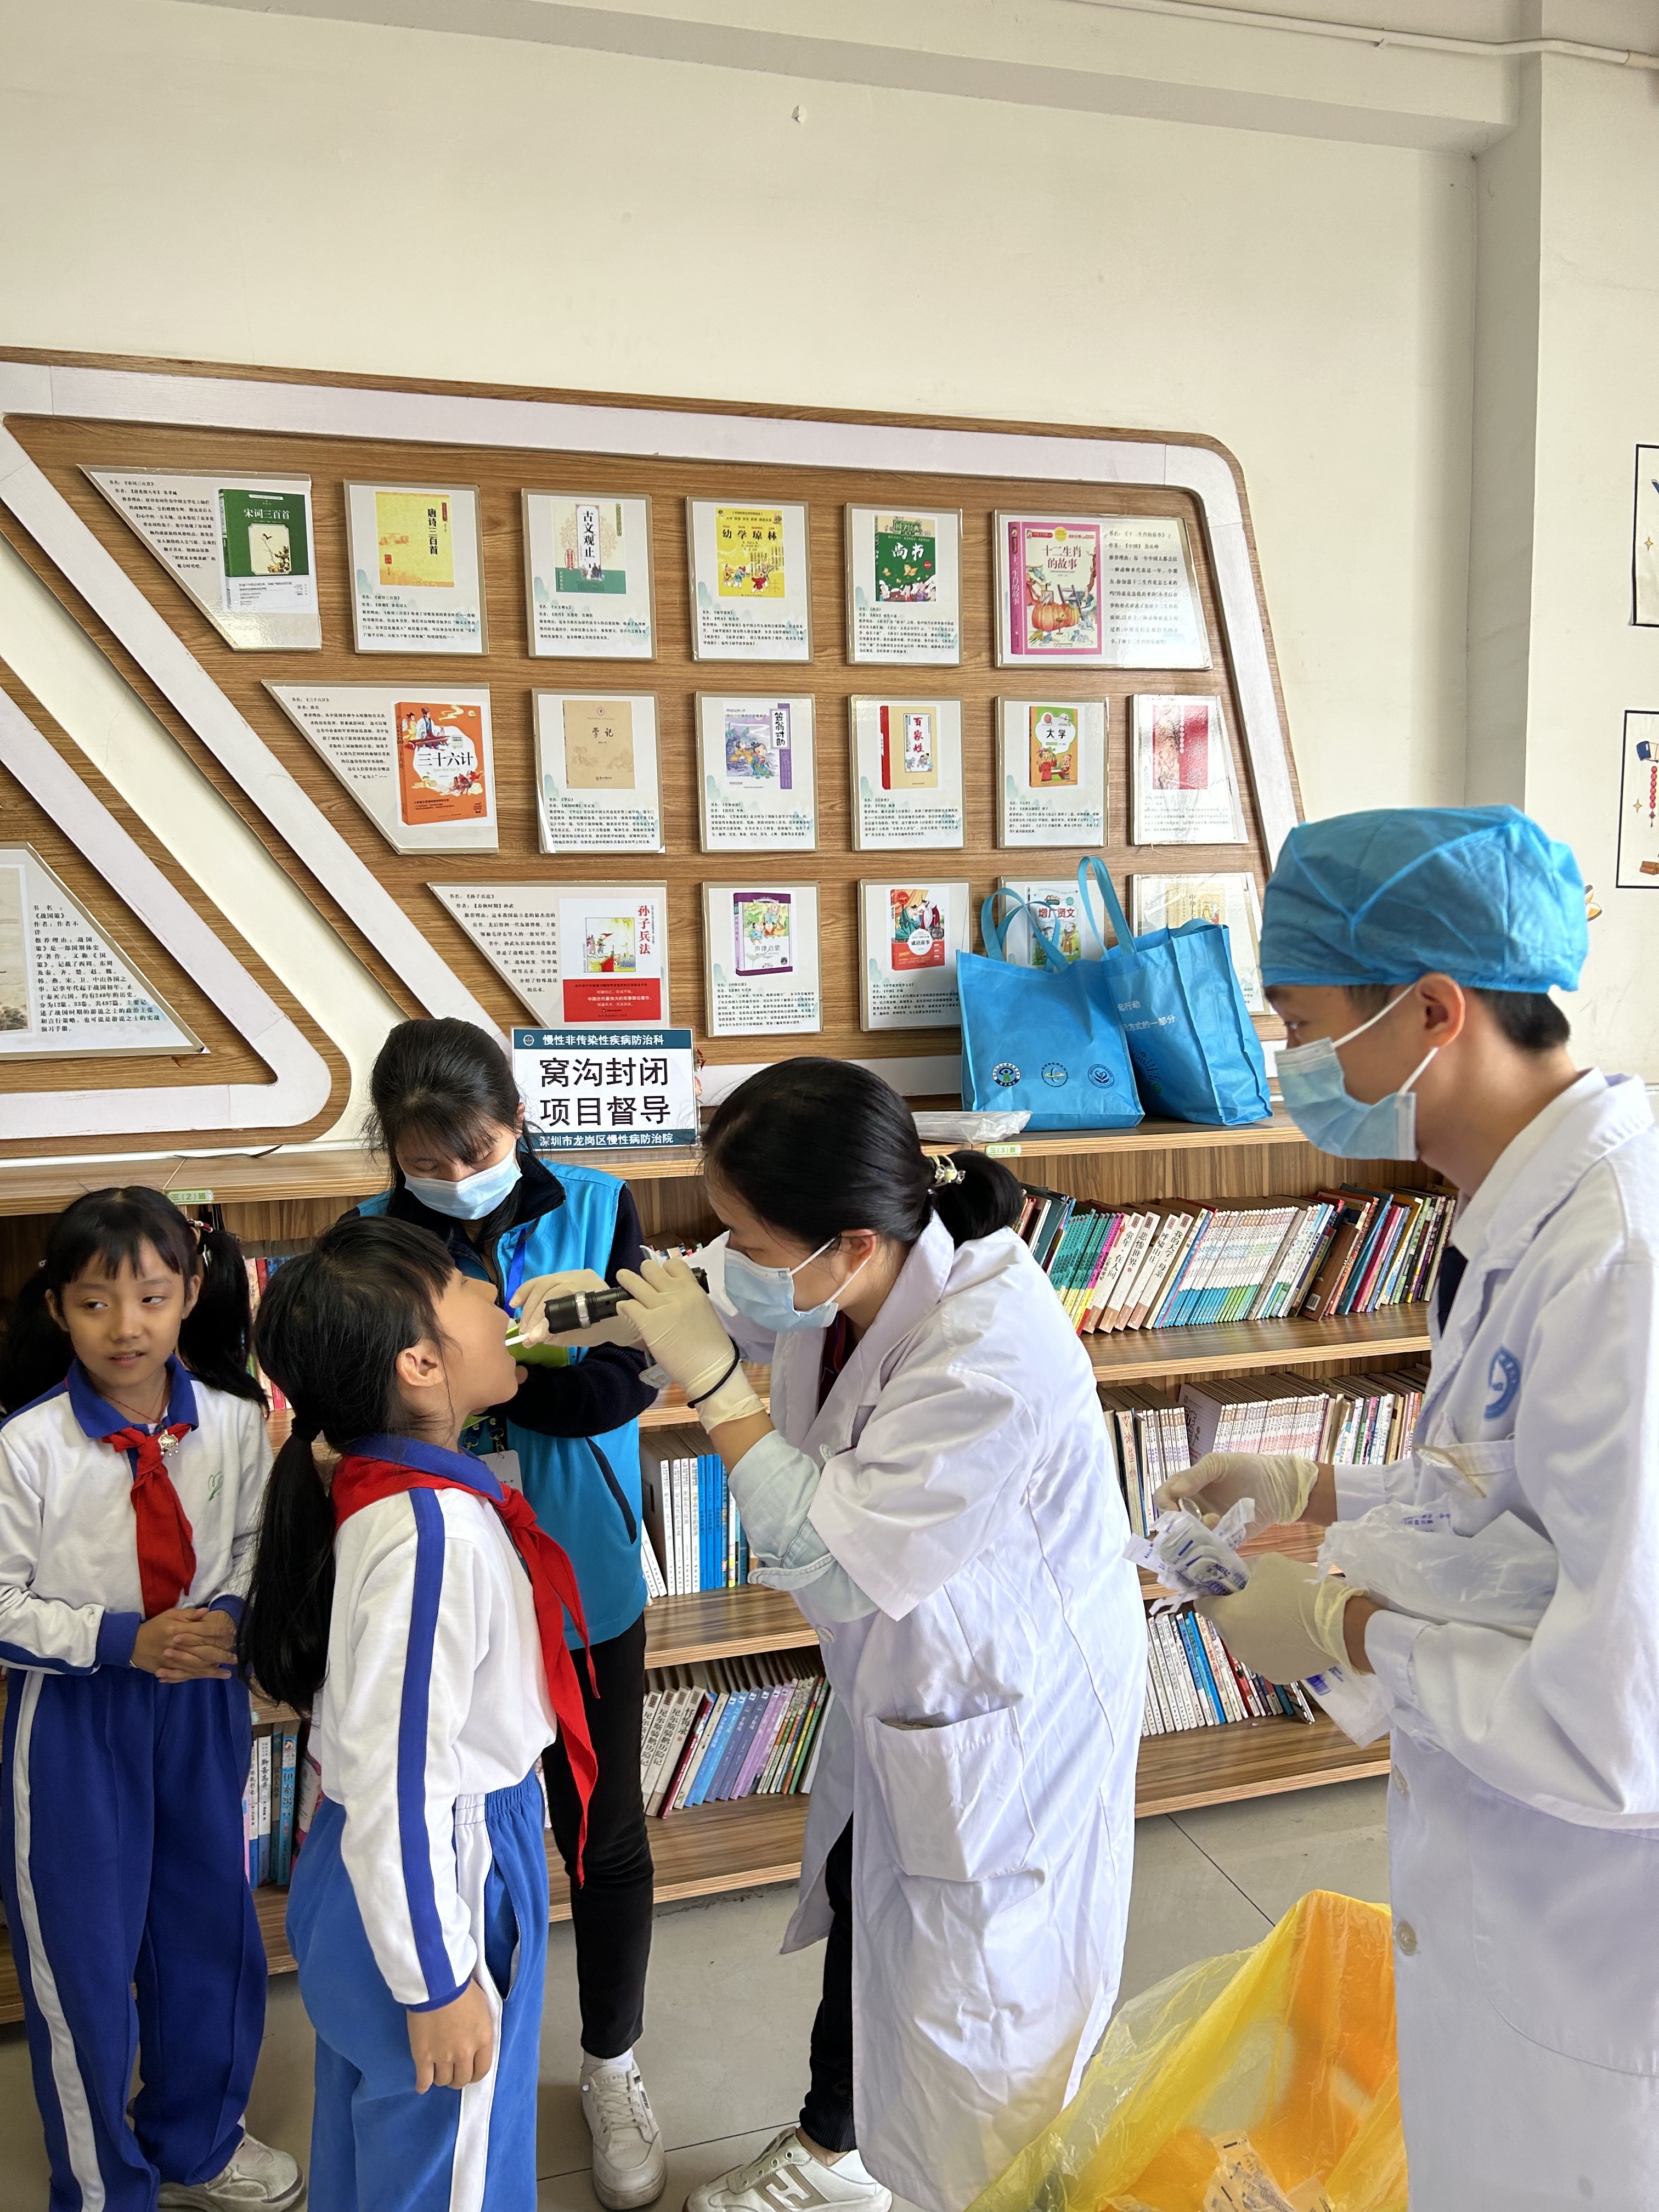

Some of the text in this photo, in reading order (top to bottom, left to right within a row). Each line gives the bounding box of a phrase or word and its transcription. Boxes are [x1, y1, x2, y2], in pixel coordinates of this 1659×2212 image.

[243, 508, 290, 520] 宋词三百首
[427, 508, 438, 555] 唐诗三百首
[583, 511, 595, 558] 古文观止
[723, 529, 777, 541] 幼学琼林
[891, 542, 924, 561] 尚书
[1042, 545, 1081, 557] 十二生肖
[1048, 558, 1077, 569] 的故事
[592, 727, 614, 738] 学记
[775, 712, 786, 746] 笠翁对韵
[913, 716, 925, 753] 百家姓
[1047, 729, 1066, 739] 大学
[418, 752, 474, 767] 三十六计
[1186, 738, 1206, 786] 诗经
[1039, 907, 1075, 918] 增广贤文
[637, 905, 651, 955] 孙子兵法
[543, 1034, 664, 1046] 慢性非传染性疾病防治科
[539, 1057, 668, 1087] 窝沟封闭
[540, 1096, 671, 1127] 项目督导
[539, 1132, 674, 1147] 深圳市龙岗区慢性病防治院
[1128, 1231, 1148, 1267] 悲惨世界
[678, 1707, 696, 1735] 忏悔录
[641, 1708, 668, 1767] 尼尔斯骑鹅历险记
[653, 1708, 681, 1766] 尼尔斯骑鹅历险记
[283, 1773, 294, 1818] 伊索寓言
